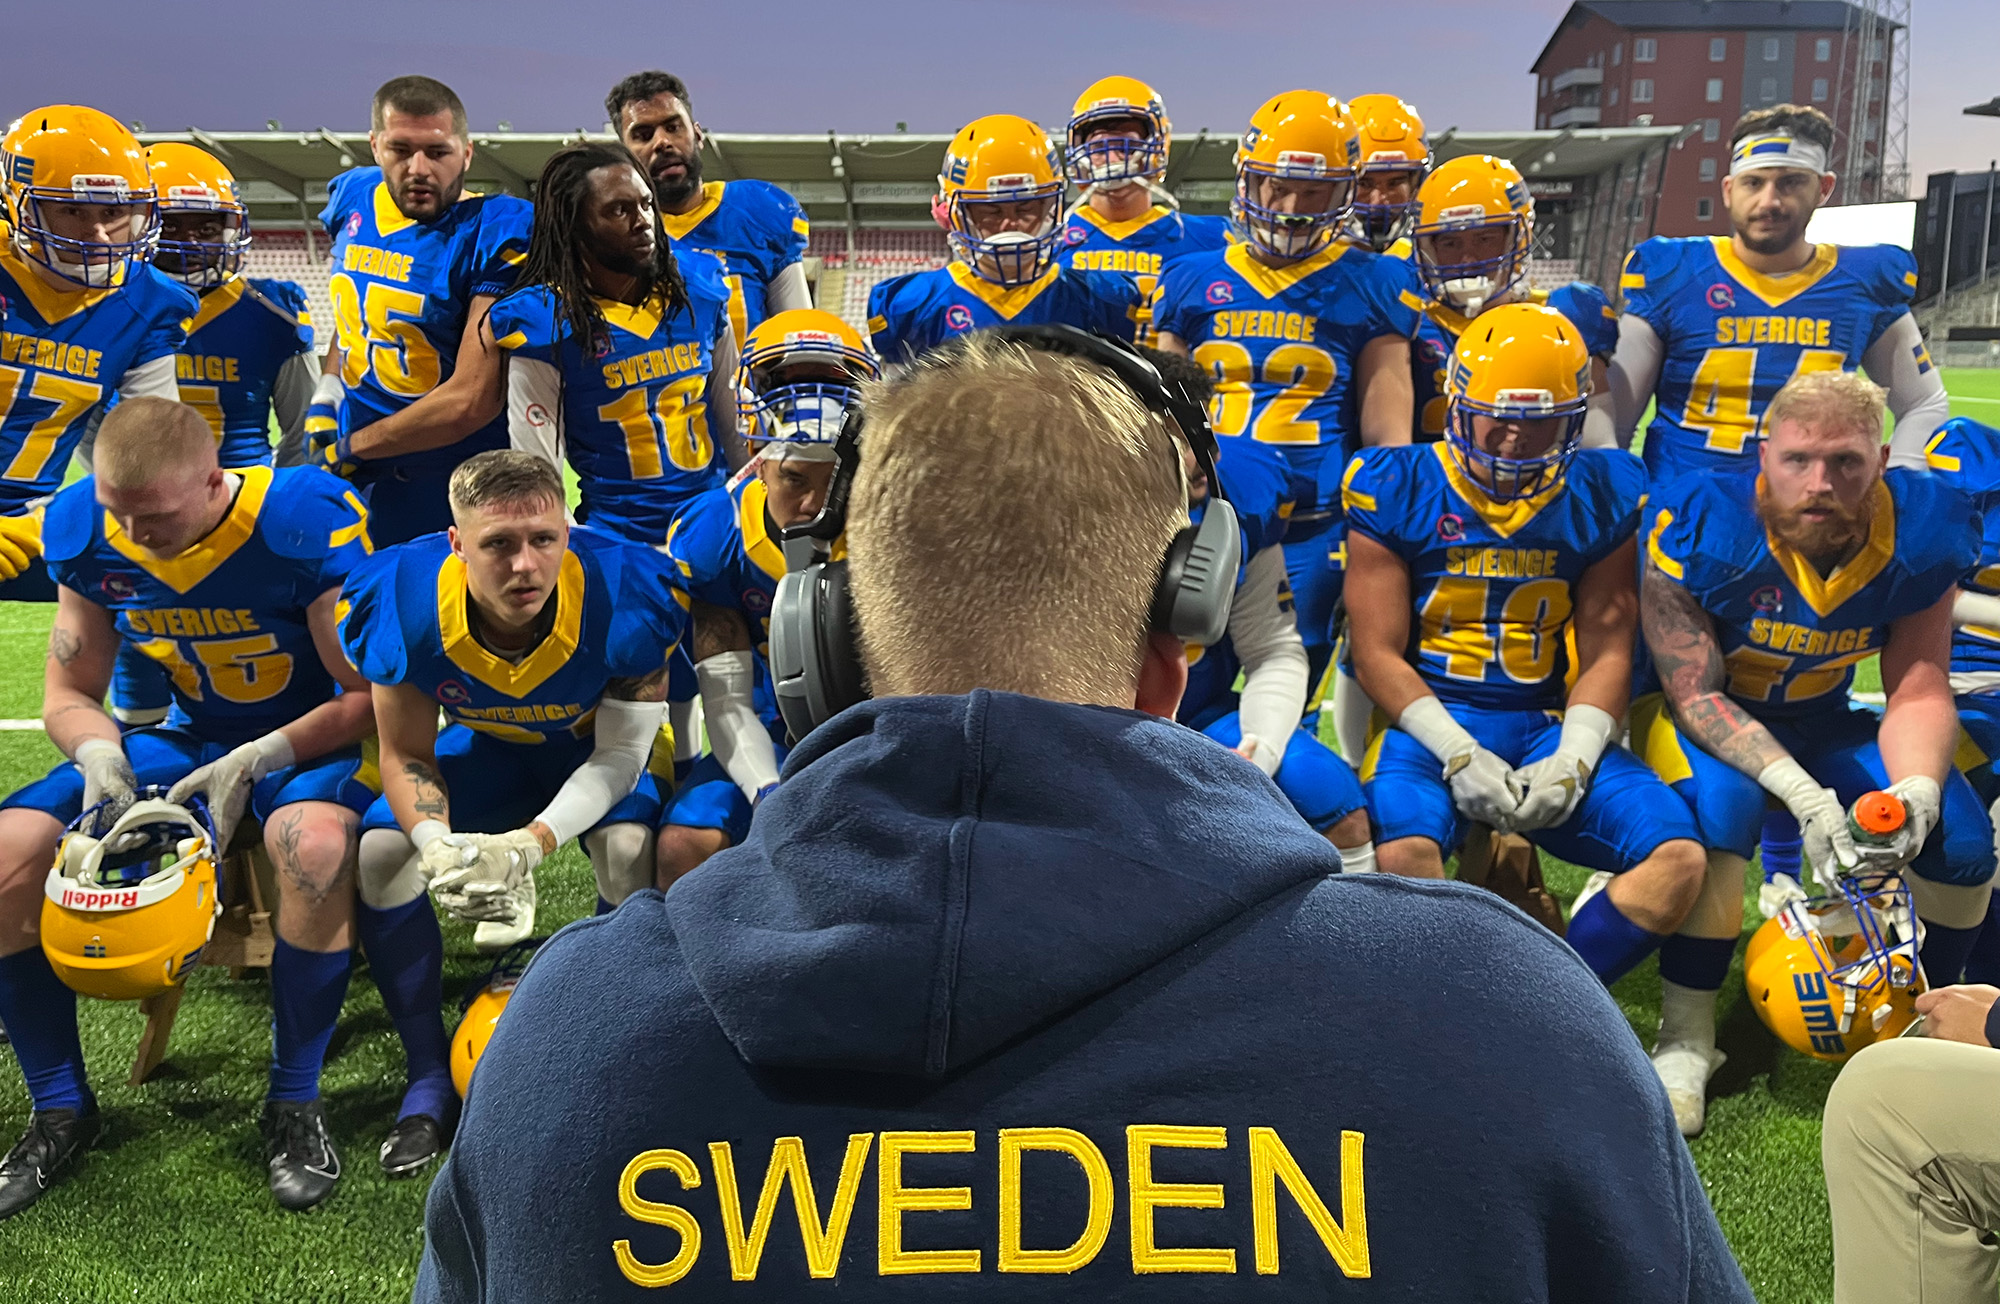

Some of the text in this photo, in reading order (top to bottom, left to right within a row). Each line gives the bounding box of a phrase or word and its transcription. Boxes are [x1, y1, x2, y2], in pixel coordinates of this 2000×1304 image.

[1071, 250, 1163, 275] SVERIGE
[1213, 310, 1317, 342] SVERIGE
[1716, 316, 1831, 347] SVERIGE
[0, 331, 102, 379] VERIGE
[175, 353, 240, 382] RIGE
[603, 341, 702, 390] SVERIGE
[598, 374, 714, 480] 16
[1445, 547, 1559, 577] SVERIGE
[126, 608, 260, 636] SVERIGE
[1749, 618, 1873, 656] SVERIGE
[61, 890, 138, 909] Riddell
[612, 1124, 1372, 1288] SWEDEN
